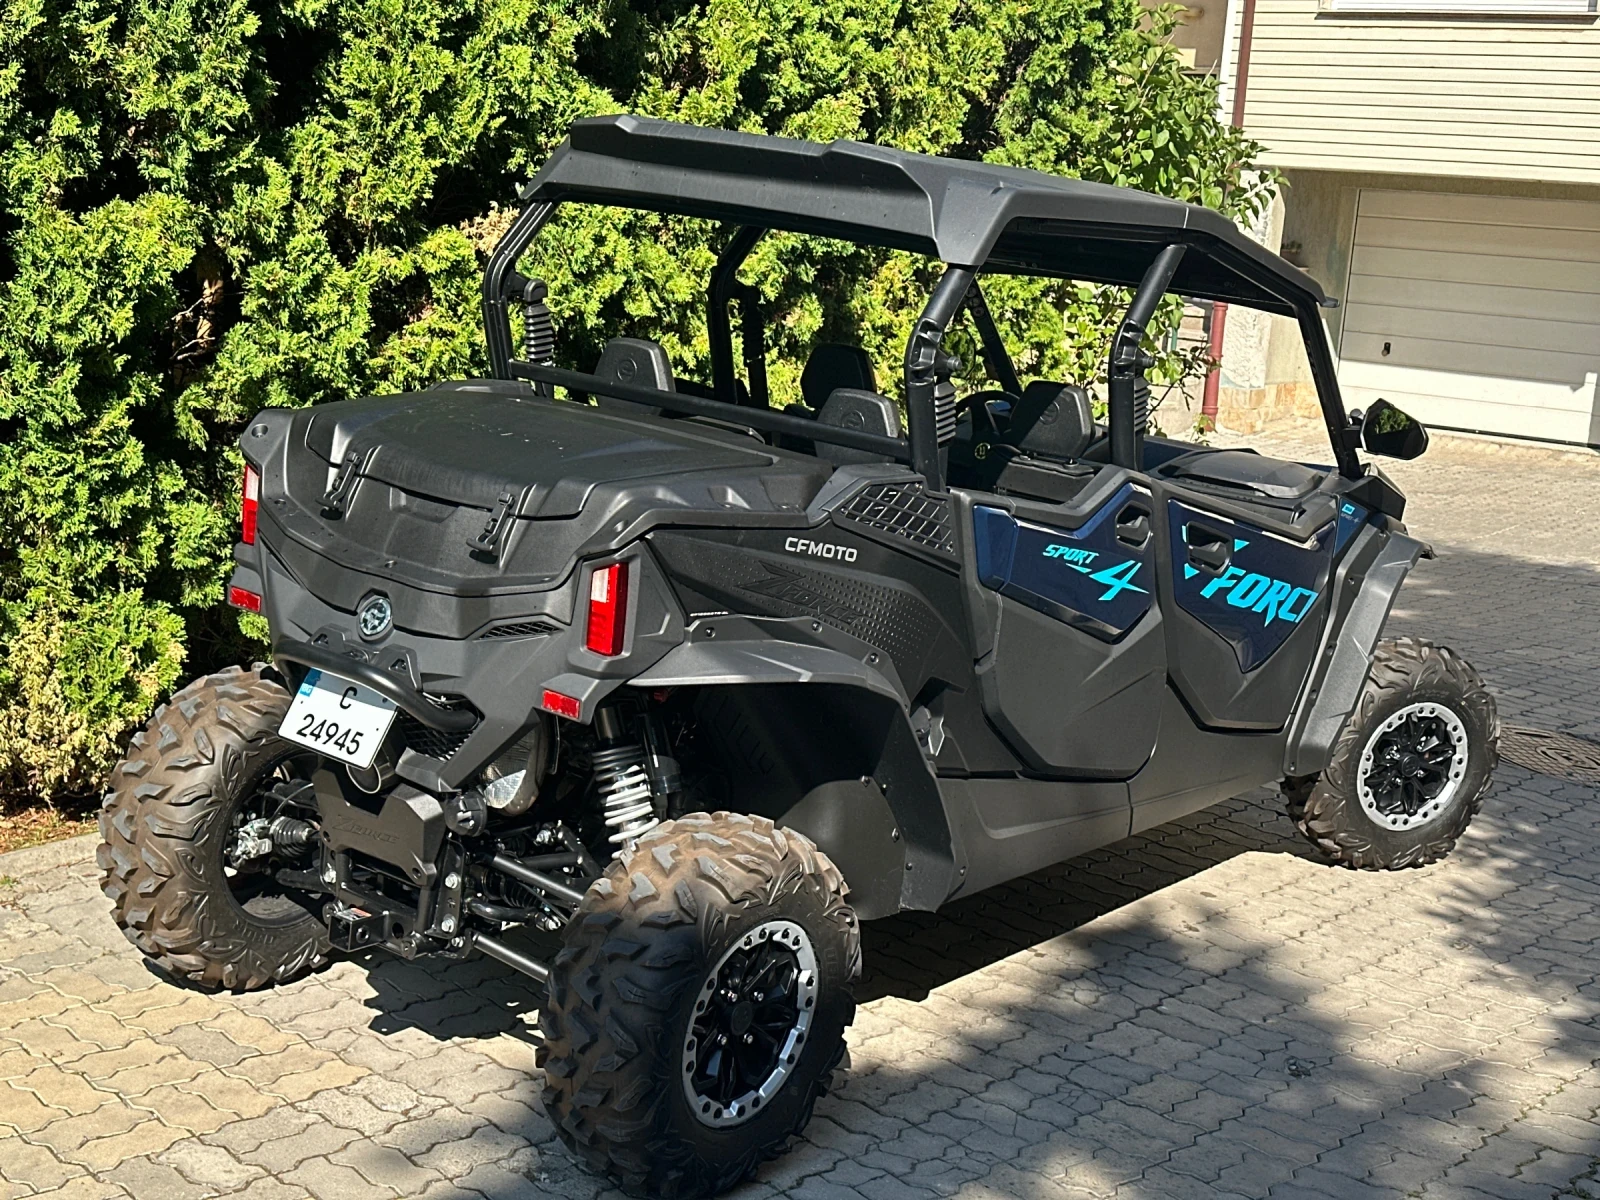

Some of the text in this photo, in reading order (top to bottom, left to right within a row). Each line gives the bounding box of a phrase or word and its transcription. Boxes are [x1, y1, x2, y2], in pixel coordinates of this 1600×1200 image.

[784, 537, 858, 563] CFMOTO
[1042, 544, 1150, 601] SPORT 4
[1199, 565, 1319, 628] FORC
[339, 686, 358, 710] C
[296, 713, 364, 756] 24945
